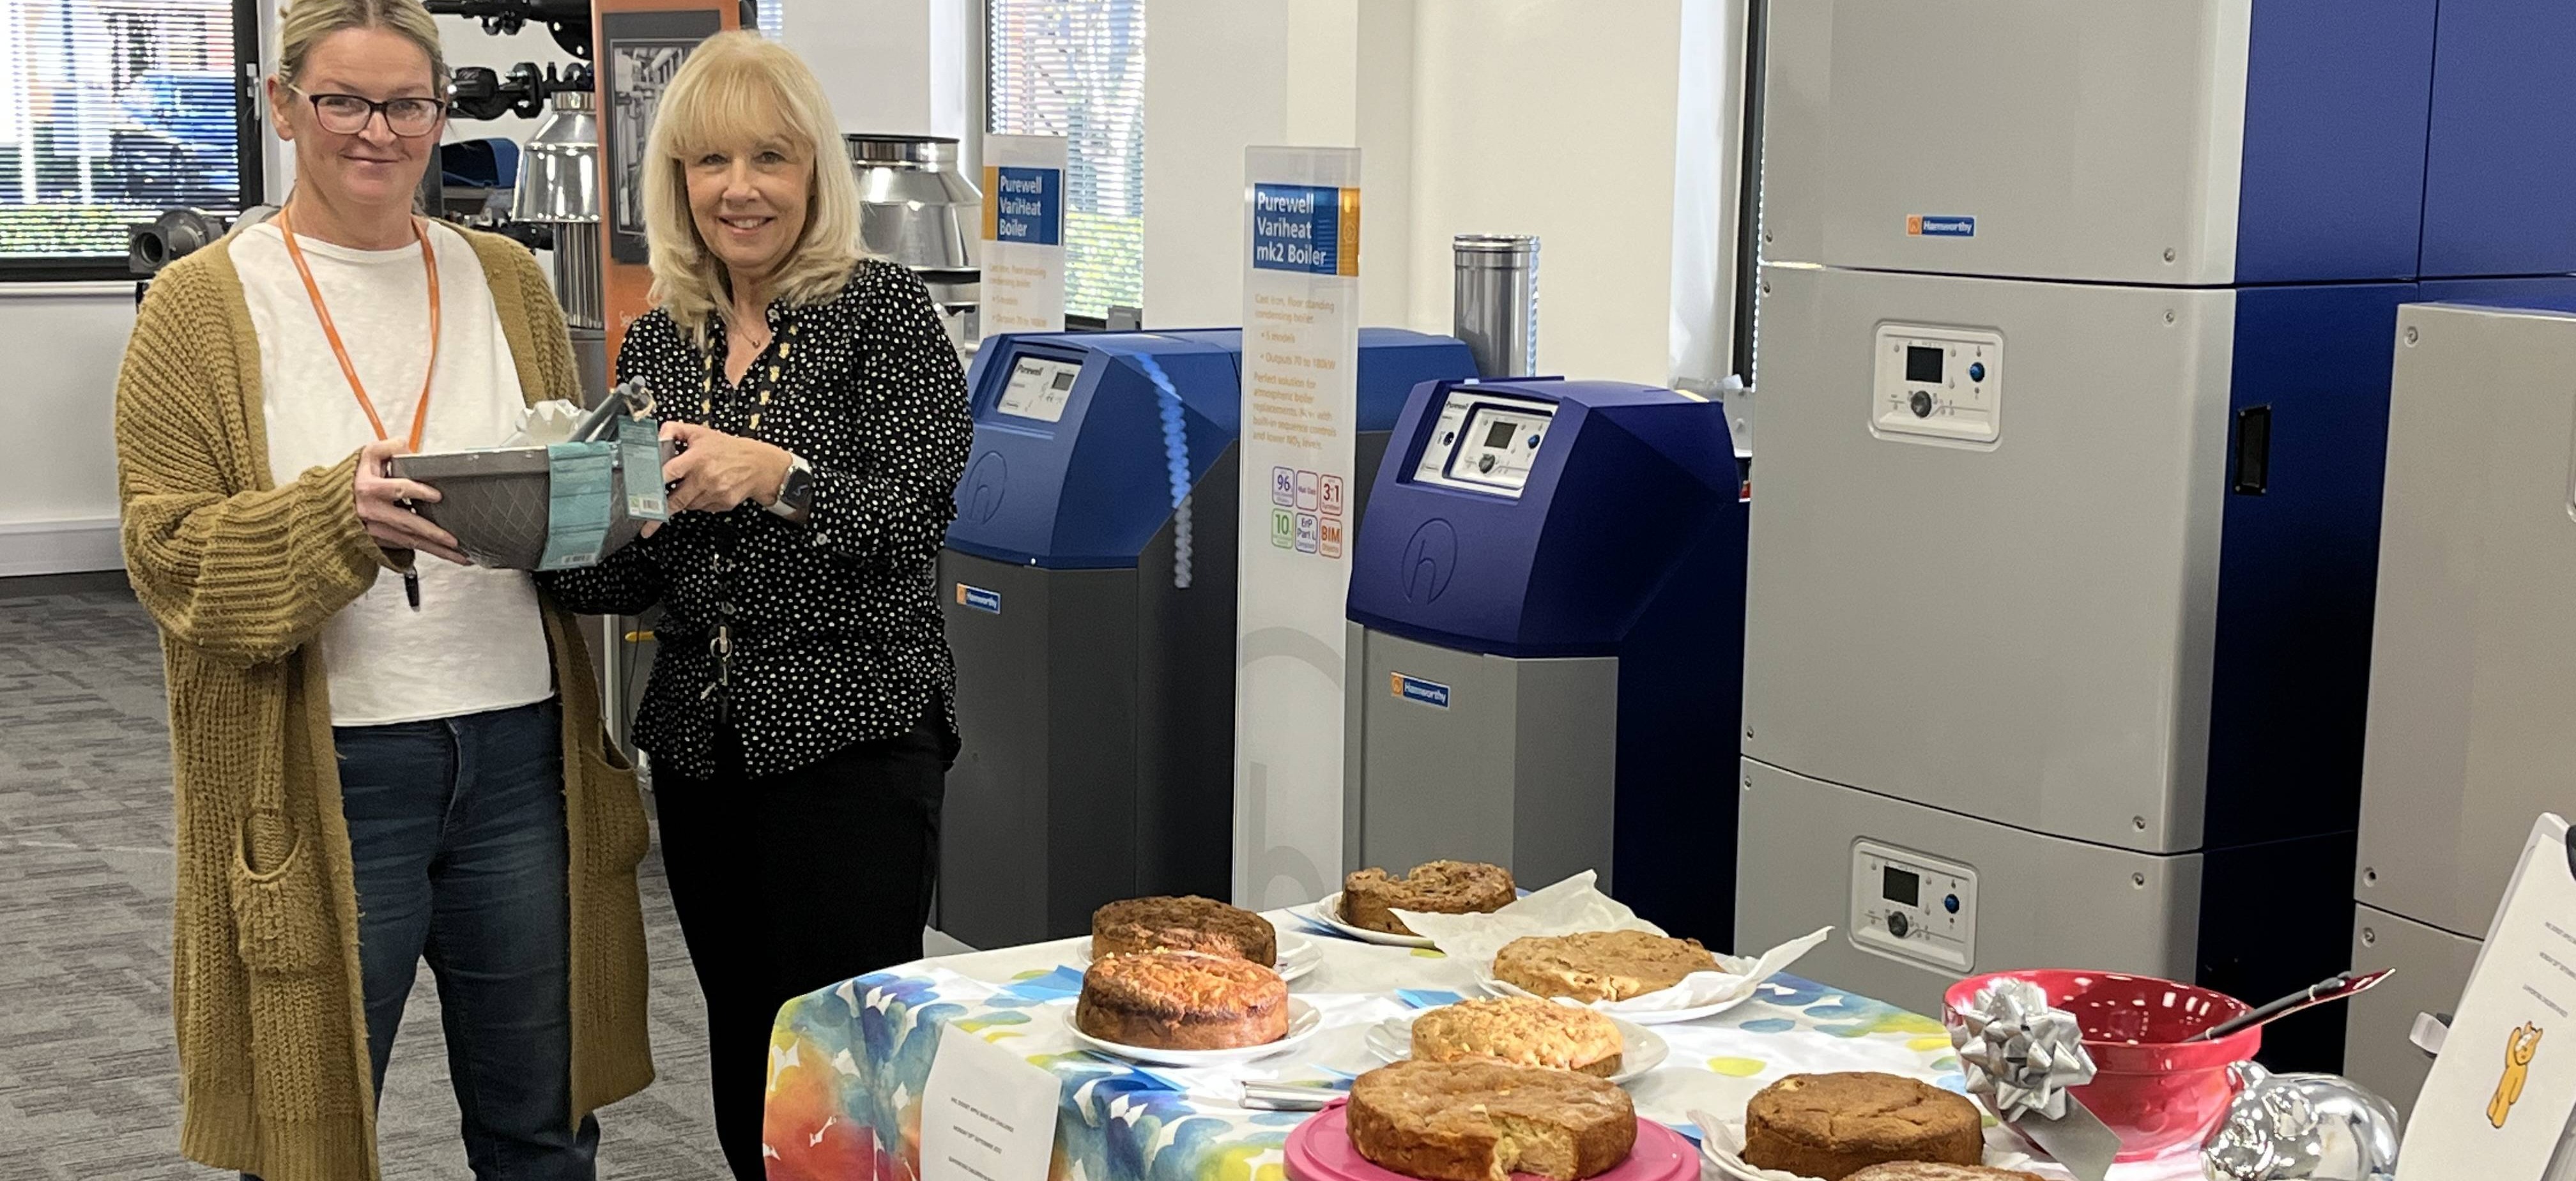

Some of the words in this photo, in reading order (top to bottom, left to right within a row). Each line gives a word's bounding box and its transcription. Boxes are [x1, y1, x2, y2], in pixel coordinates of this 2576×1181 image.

[1000, 175, 1042, 194] Purewell
[1000, 196, 1041, 216] VariHeat
[1257, 192, 1314, 214] Purewell
[999, 218, 1027, 237] Boiler
[1257, 217, 1312, 240] Variheat
[1924, 220, 1972, 234] Hamworthy
[1257, 241, 1284, 263] mk2
[1288, 243, 1326, 266] Boiler
[1277, 475, 1290, 491] 96
[1275, 514, 1290, 535] 10
[1321, 525, 1340, 543] BIM
[1405, 682, 1446, 704] Hamworthy
